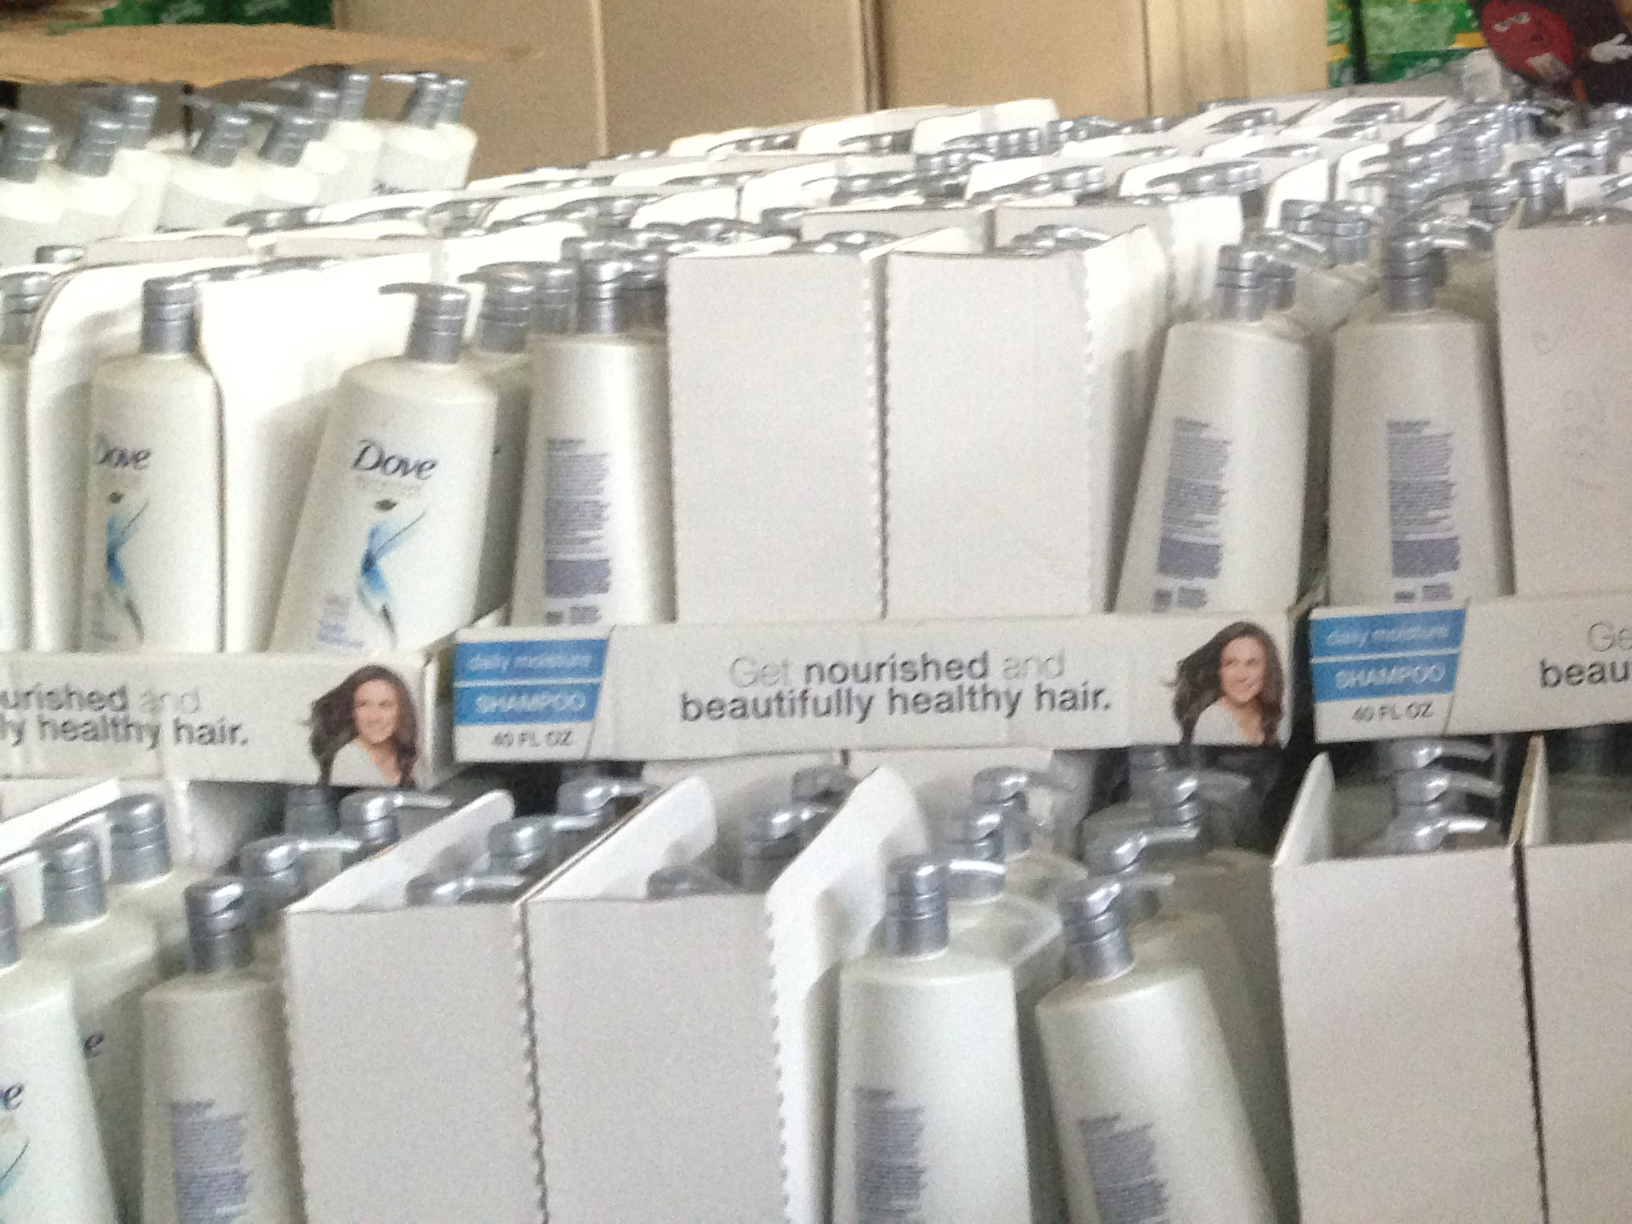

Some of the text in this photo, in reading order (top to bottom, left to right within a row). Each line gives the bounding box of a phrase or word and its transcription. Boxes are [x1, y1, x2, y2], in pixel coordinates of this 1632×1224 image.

[350, 437, 439, 481] Dove
[728, 645, 1066, 689] Get nourished and
[1335, 662, 1447, 690] SHAMPOO
[0, 682, 130, 713] urished
[475, 690, 588, 714] SHAMPOO
[680, 679, 1112, 725] beautifully healthy hair.
[1404, 701, 1436, 720] OZ
[38, 713, 162, 751] healthy
[173, 716, 249, 746] hair.
[545, 728, 574, 748] OZ
